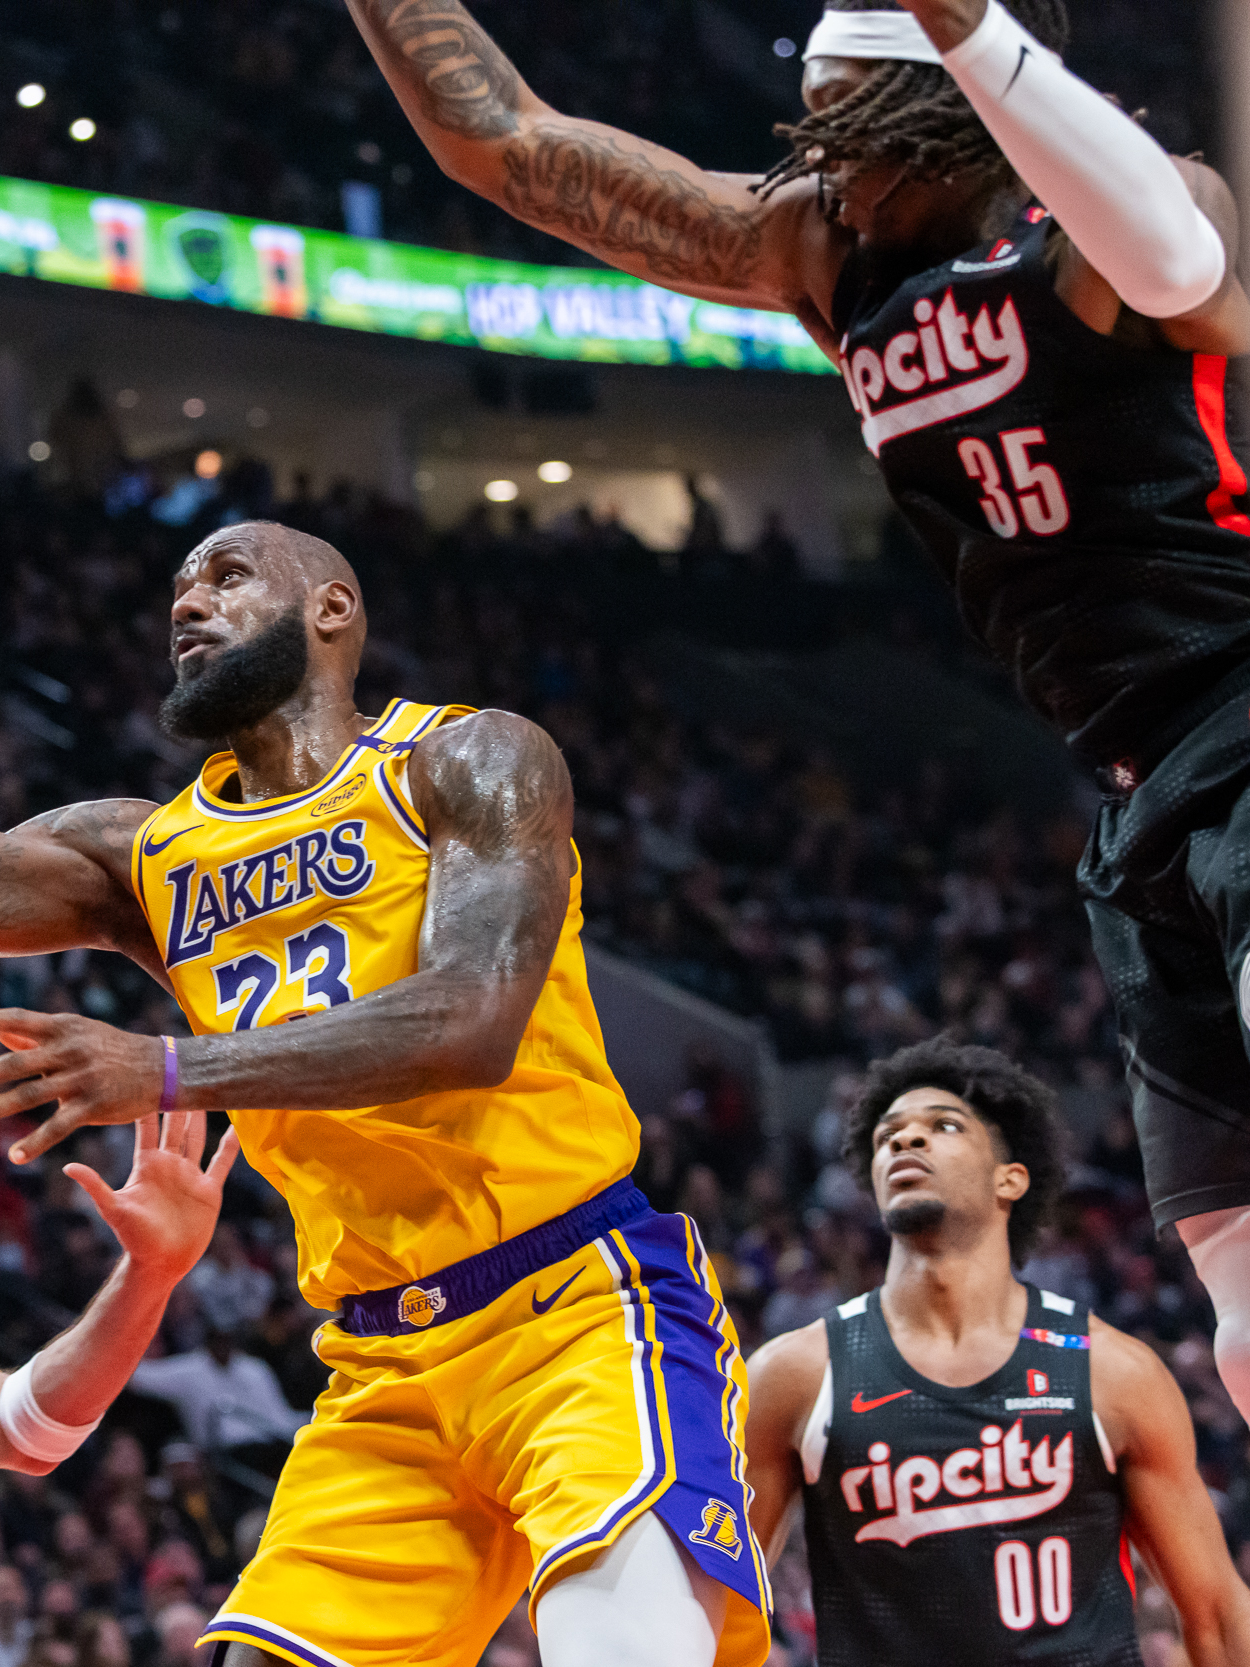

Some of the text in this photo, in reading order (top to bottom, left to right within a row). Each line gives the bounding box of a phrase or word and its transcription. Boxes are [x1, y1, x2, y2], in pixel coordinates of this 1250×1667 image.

[957, 426, 1071, 539] 35
[164, 818, 377, 973] LAKERS
[210, 919, 355, 1032] 23
[399, 1295, 444, 1320] LAKERS
[840, 1417, 1074, 1548] ripcity
[994, 1535, 1073, 1631] 00
